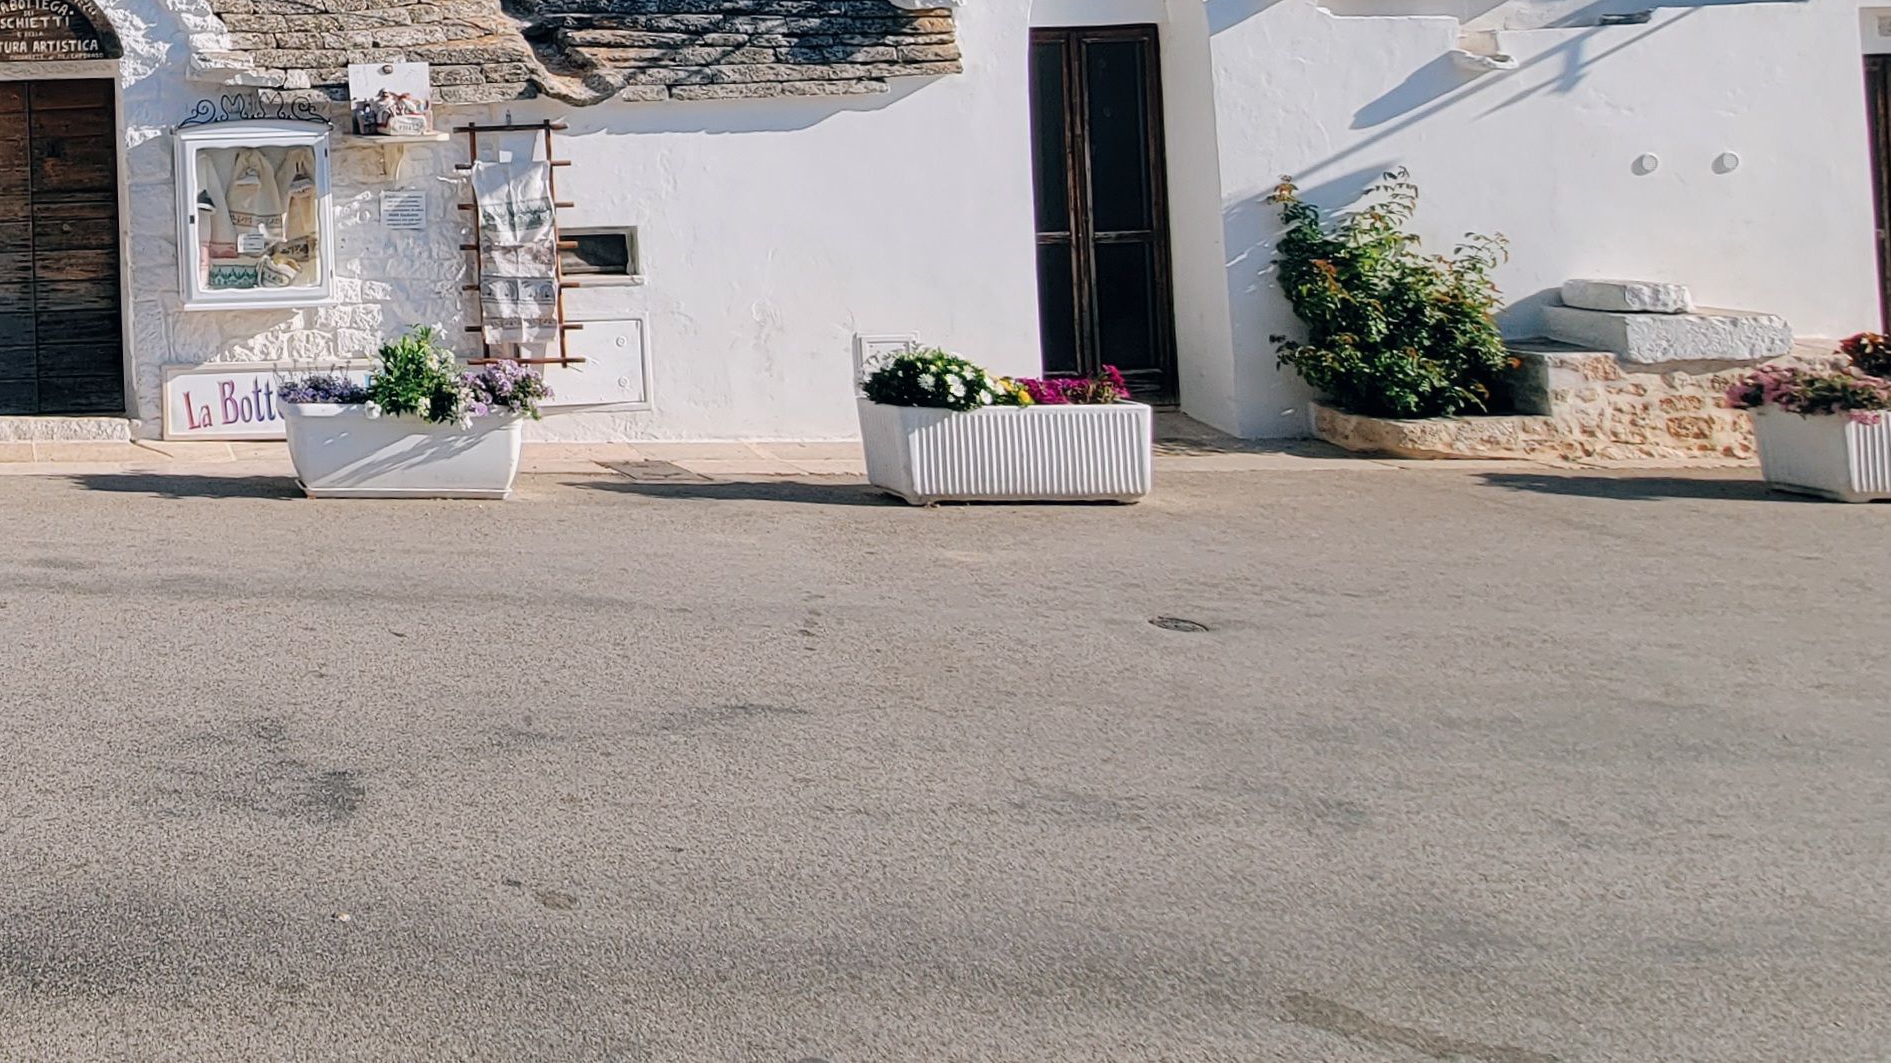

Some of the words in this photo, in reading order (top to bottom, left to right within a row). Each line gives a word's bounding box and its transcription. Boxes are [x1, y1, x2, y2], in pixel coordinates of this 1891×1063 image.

[32, 39, 99, 53] ARTISTICA
[182, 391, 214, 430] La
[217, 375, 286, 426] Bott
